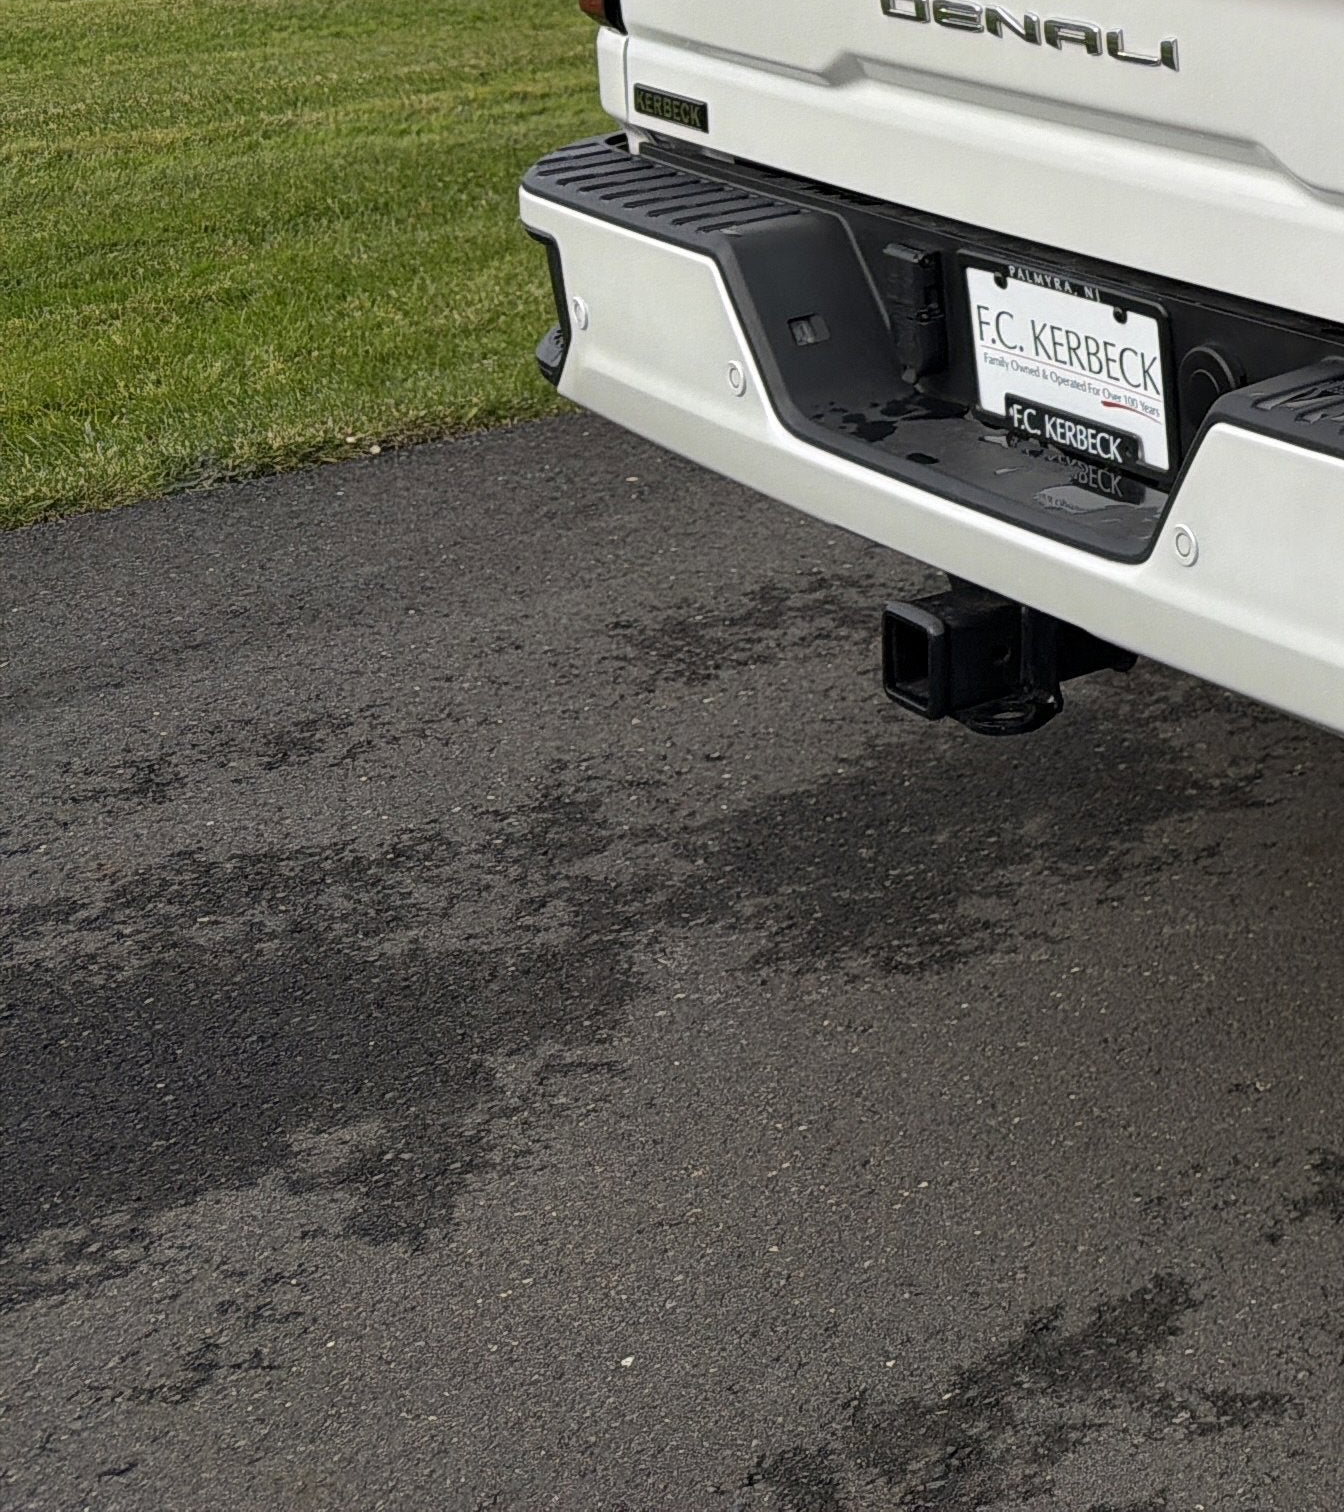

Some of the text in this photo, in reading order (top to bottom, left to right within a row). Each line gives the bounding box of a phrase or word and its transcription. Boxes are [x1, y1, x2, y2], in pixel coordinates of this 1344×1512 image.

[636, 91, 701, 127] KERBECK
[1008, 265, 1078, 296] PALMYRA,
[976, 305, 1160, 395] F.C. KERBECK
[984, 352, 1008, 370] Family
[1011, 360, 1040, 378] Owned
[1050, 371, 1087, 392] Operated
[1088, 383, 1100, 395] For
[1102, 389, 1122, 403] Over
[1124, 394, 1138, 409] 100
[1139, 400, 1161, 417] Years
[1013, 404, 1123, 464] F.C. KERBECK
